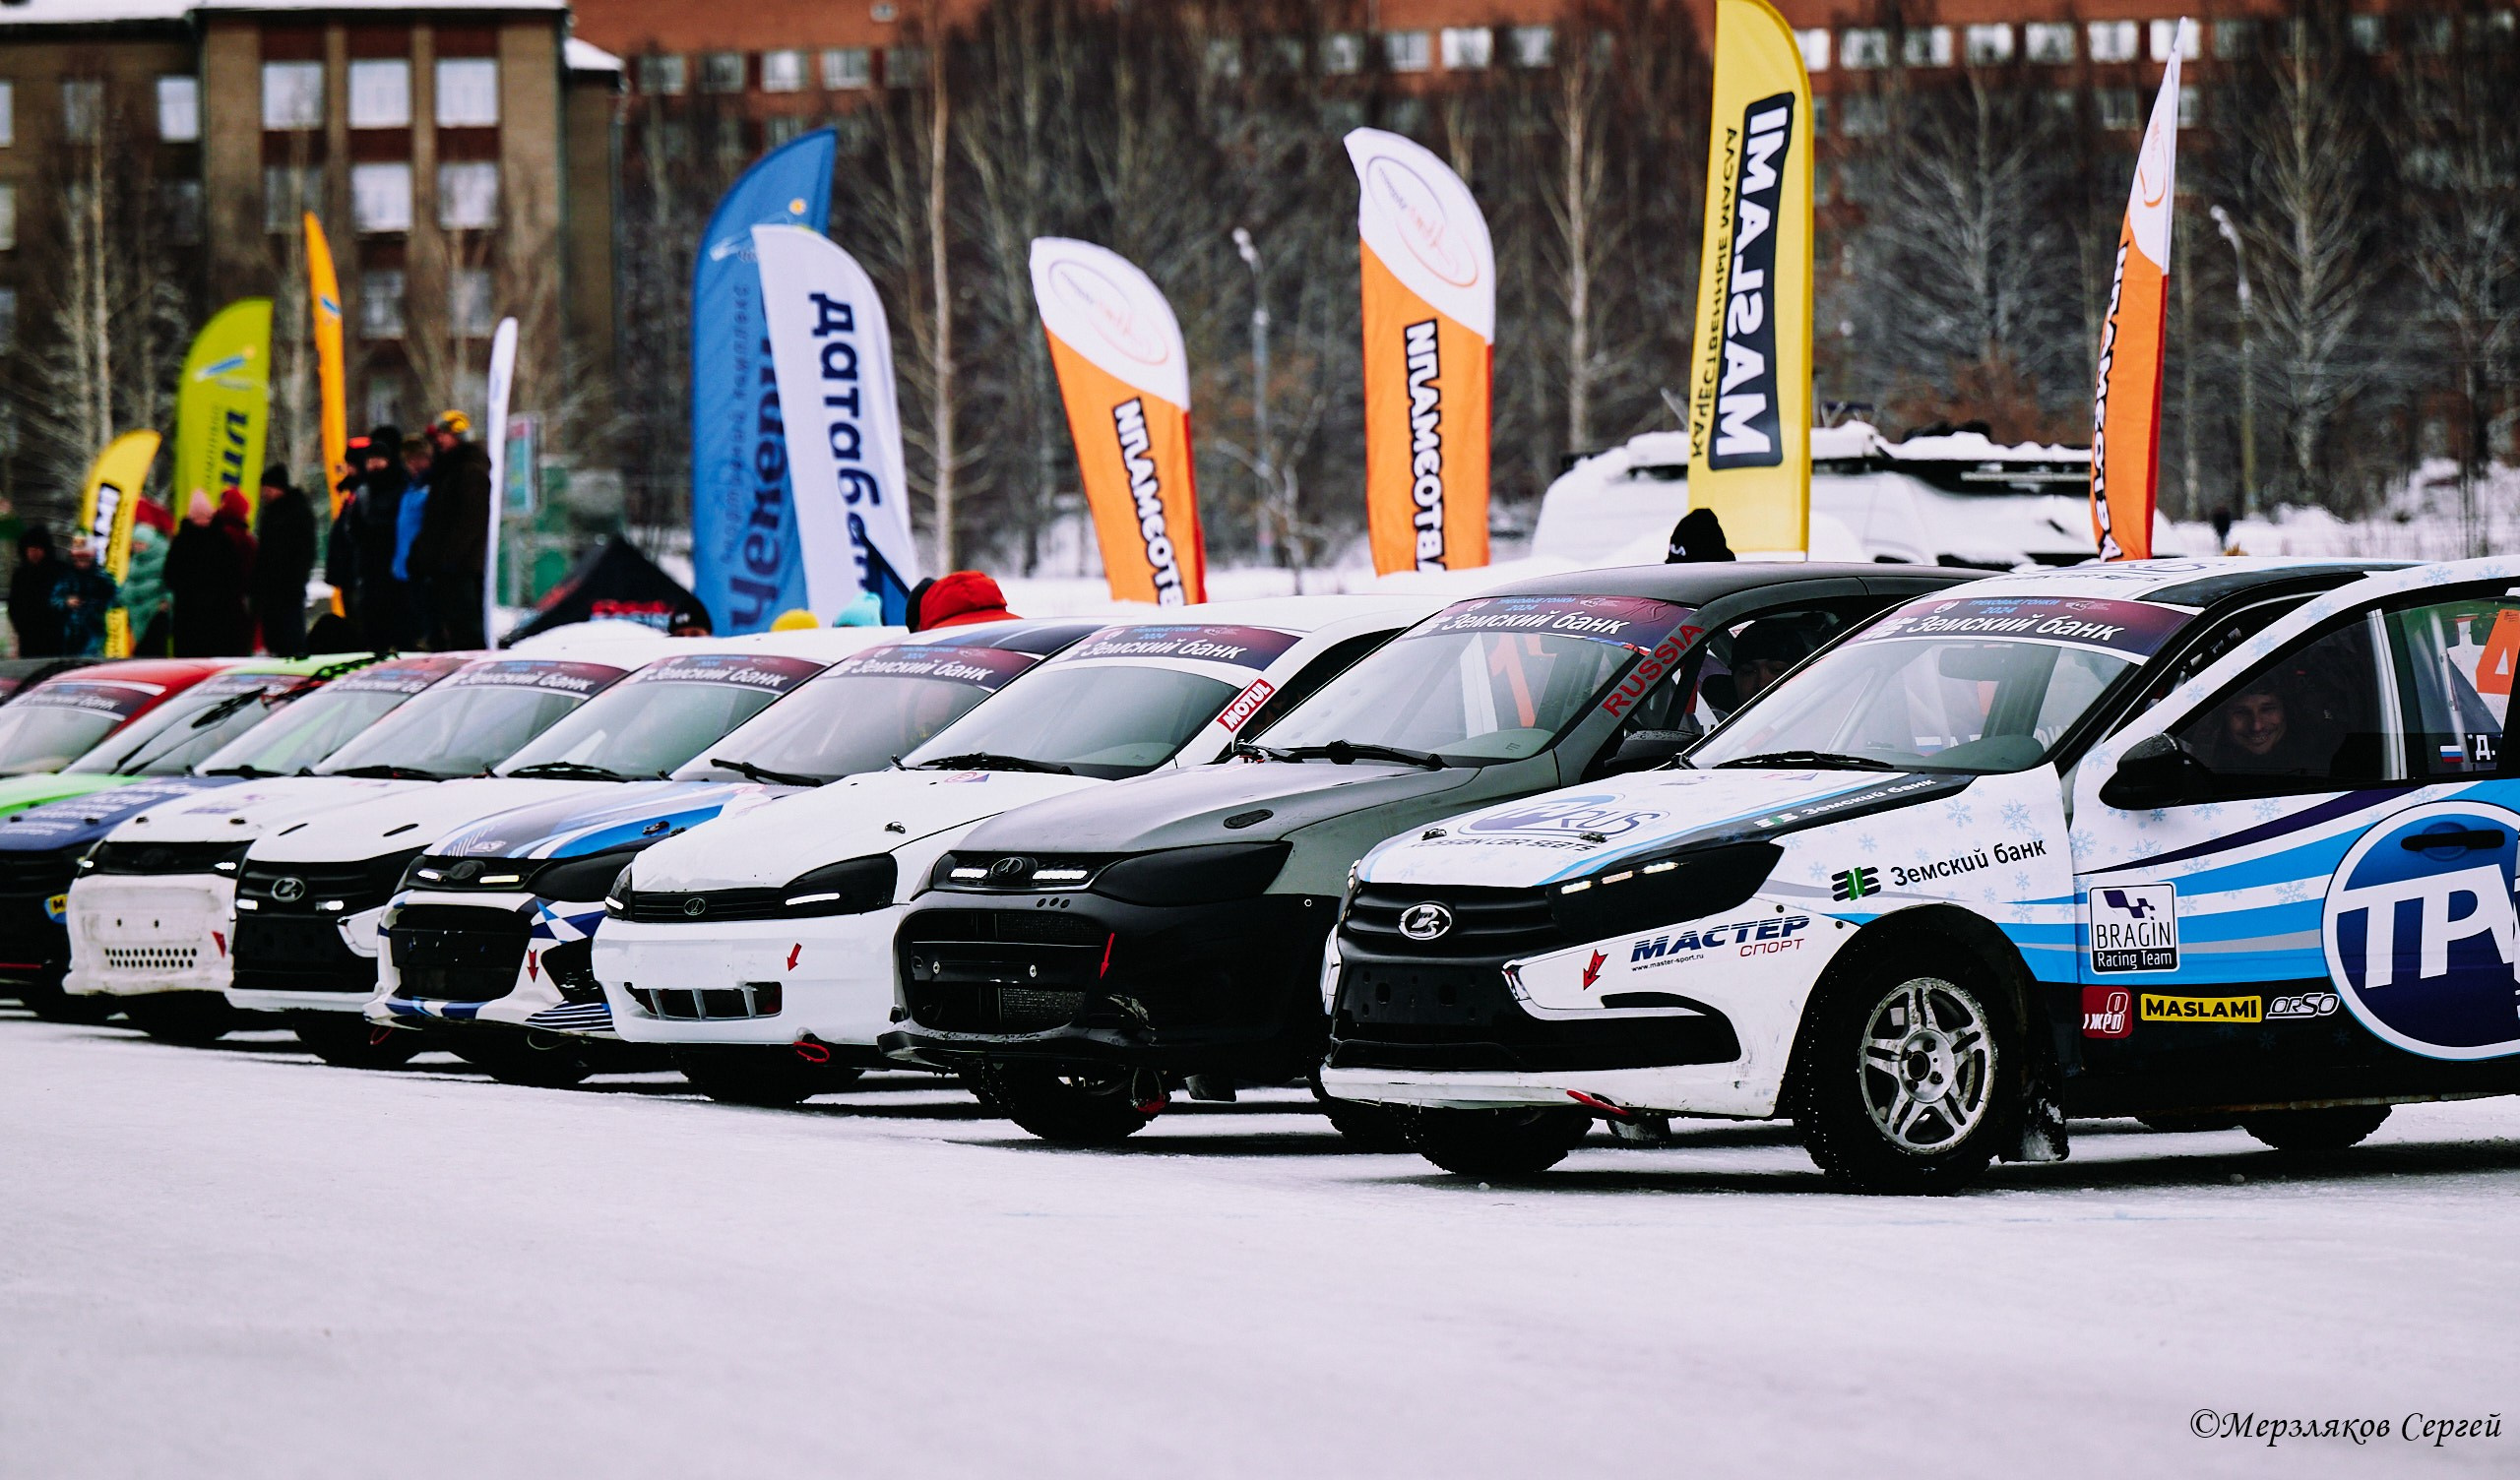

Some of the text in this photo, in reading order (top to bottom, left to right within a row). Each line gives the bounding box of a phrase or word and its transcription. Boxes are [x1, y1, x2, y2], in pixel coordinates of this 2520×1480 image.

[729, 295, 788, 627] Чекер
[1444, 608, 1631, 636] Земский банк
[1980, 606, 2018, 615] 2024
[1907, 613, 2124, 642] Земский банк
[1081, 638, 1248, 660] Земский банк
[728, 666, 788, 688] банк
[933, 660, 994, 681] банк
[1602, 624, 1706, 718] RUSSIA
[1222, 681, 1273, 730] MOTUL
[1800, 778, 1937, 816] Земский банк
[1889, 838, 2048, 887] Земский банк
[1630, 914, 1810, 962] МАСТЕР
[1739, 938, 1805, 957] СПОРТ
[1631, 954, 1705, 972] www.master-sport.ru
[2097, 951, 2173, 970] Racing Team
[2145, 998, 2257, 1018] MASLAMI
